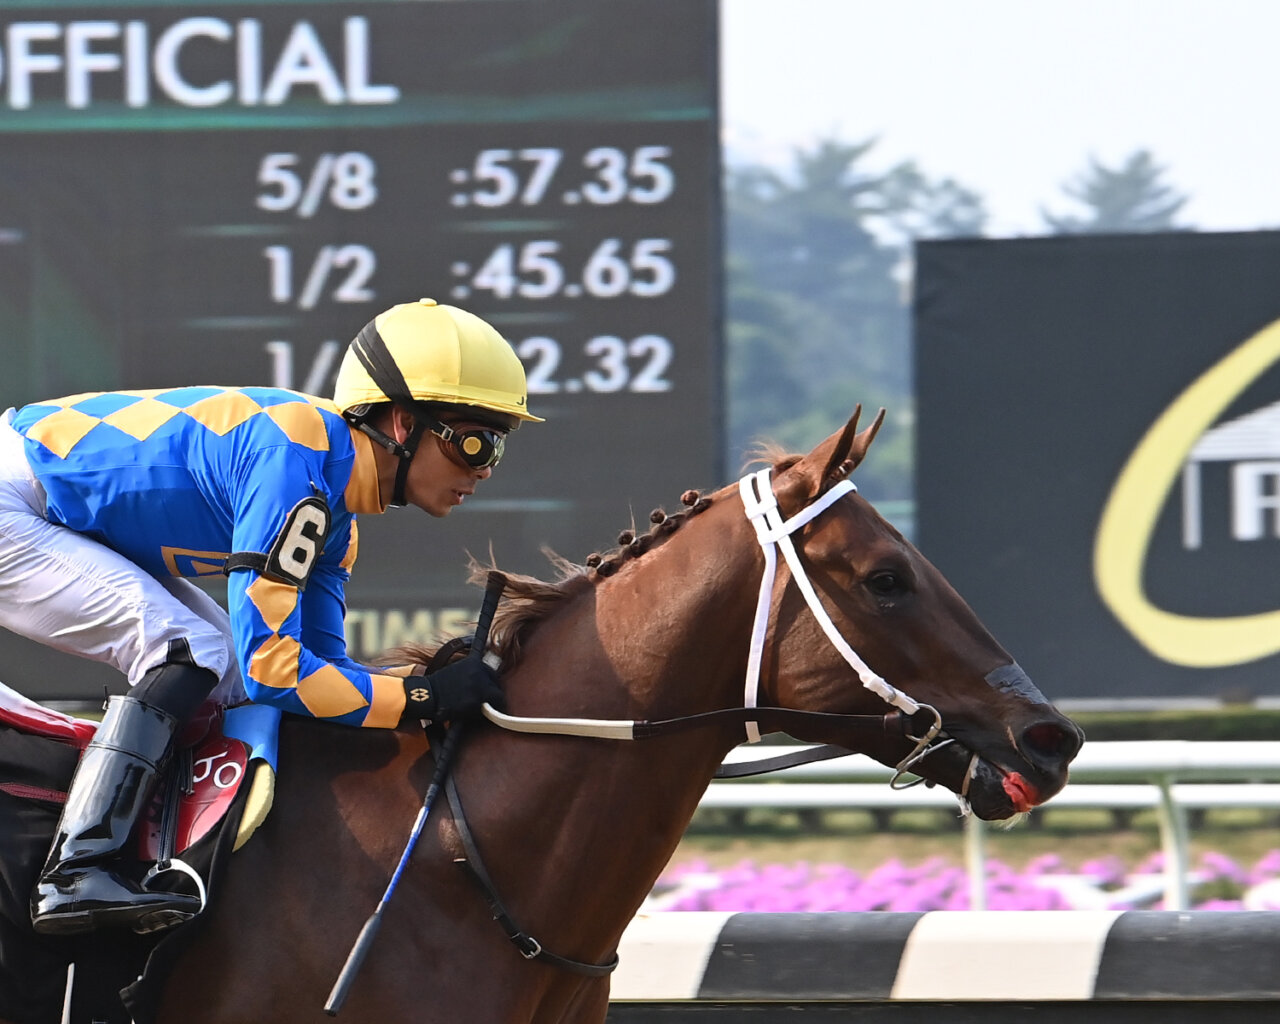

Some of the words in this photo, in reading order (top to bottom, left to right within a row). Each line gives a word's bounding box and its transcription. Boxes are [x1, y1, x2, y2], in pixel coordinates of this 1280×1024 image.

[257, 151, 377, 218] 5/8
[449, 146, 676, 207] :57.35
[264, 244, 376, 309] 1/2
[449, 238, 676, 299] :45.65
[266, 340, 340, 397] 1/
[519, 334, 674, 394] 2.32
[278, 504, 326, 580] 6
